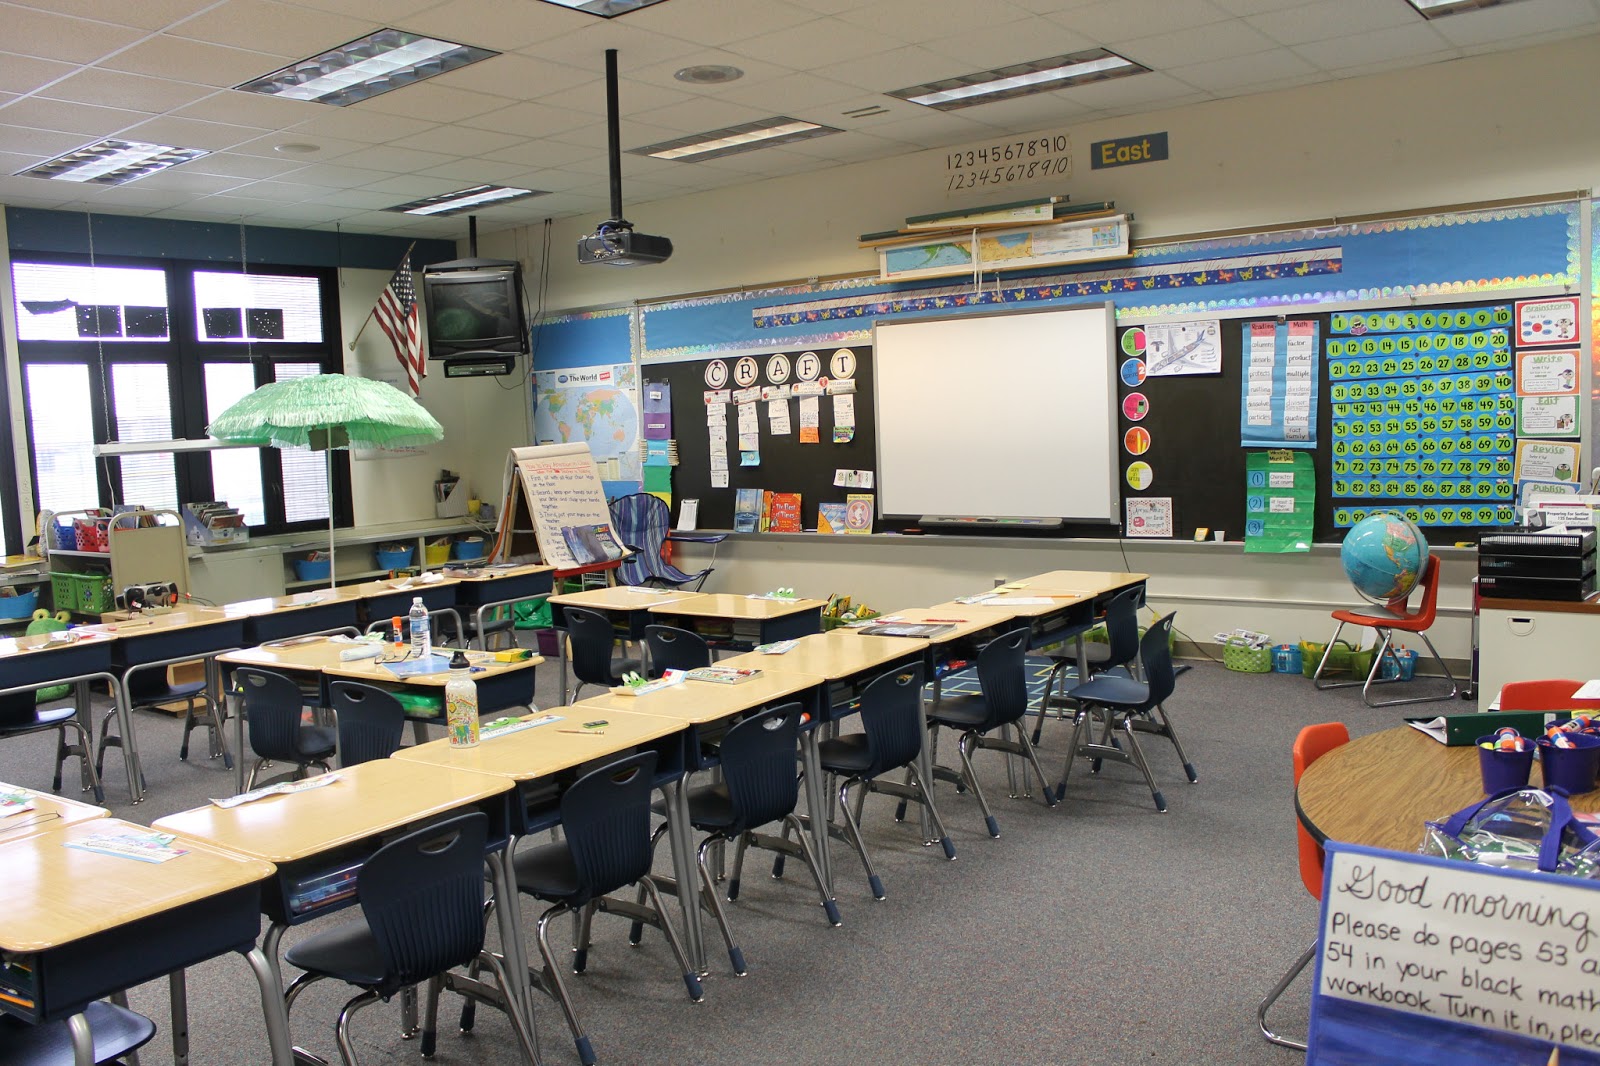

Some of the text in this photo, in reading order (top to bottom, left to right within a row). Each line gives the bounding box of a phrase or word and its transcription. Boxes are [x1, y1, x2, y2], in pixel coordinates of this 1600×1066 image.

[1101, 139, 1151, 164] East
[1525, 303, 1571, 313] Brainstorm
[1372, 312, 1508, 327] 3 4 5 6 7 8 9 10
[1332, 335, 1505, 353] 11 12 13 14 15 16 17 18 19 20
[1288, 354, 1311, 364] product
[1333, 353, 1508, 375] 21 22 23 24 25 26 27 28 29 30
[1532, 355, 1563, 363] Write
[580, 374, 598, 382] World
[1335, 377, 1509, 397] 31 32 33 34 35 36 37 38 39 40
[1337, 399, 1513, 413] 41 42 43 44 45 46 47 48 49 50
[1538, 396, 1559, 405] Edit
[1353, 416, 1511, 433] 52 53 54 55 56 57 58 59 60
[1352, 439, 1511, 453] 62 63 64 65 66 67 68 69 70
[1532, 445, 1565, 454] Revise
[1353, 462, 1510, 472] 72 73 74 75 76 77 78 79 80
[1352, 483, 1510, 494] 82 83 84 85 86 87 88 89 90
[1533, 484, 1565, 494] Publish
[1338, 513, 1347, 522] 91
[1406, 512, 1418, 521] 95
[1424, 512, 1436, 521] 96
[1441, 511, 1454, 520] 97
[1460, 511, 1472, 520] 98
[1479, 511, 1492, 520] 99
[1497, 511, 1512, 520] 100
[1338, 865, 1598, 953] Good morning
[1332, 912, 1401, 941] Please
[1414, 923, 1440, 946] do
[1450, 935, 1522, 964] pages
[1536, 941, 1568, 966] 53
[1326, 941, 1600, 1013] 54 in your black math
[1440, 993, 1495, 1024] Turn
[1504, 1010, 1520, 1030] it
[1528, 1016, 1554, 1041] in,
